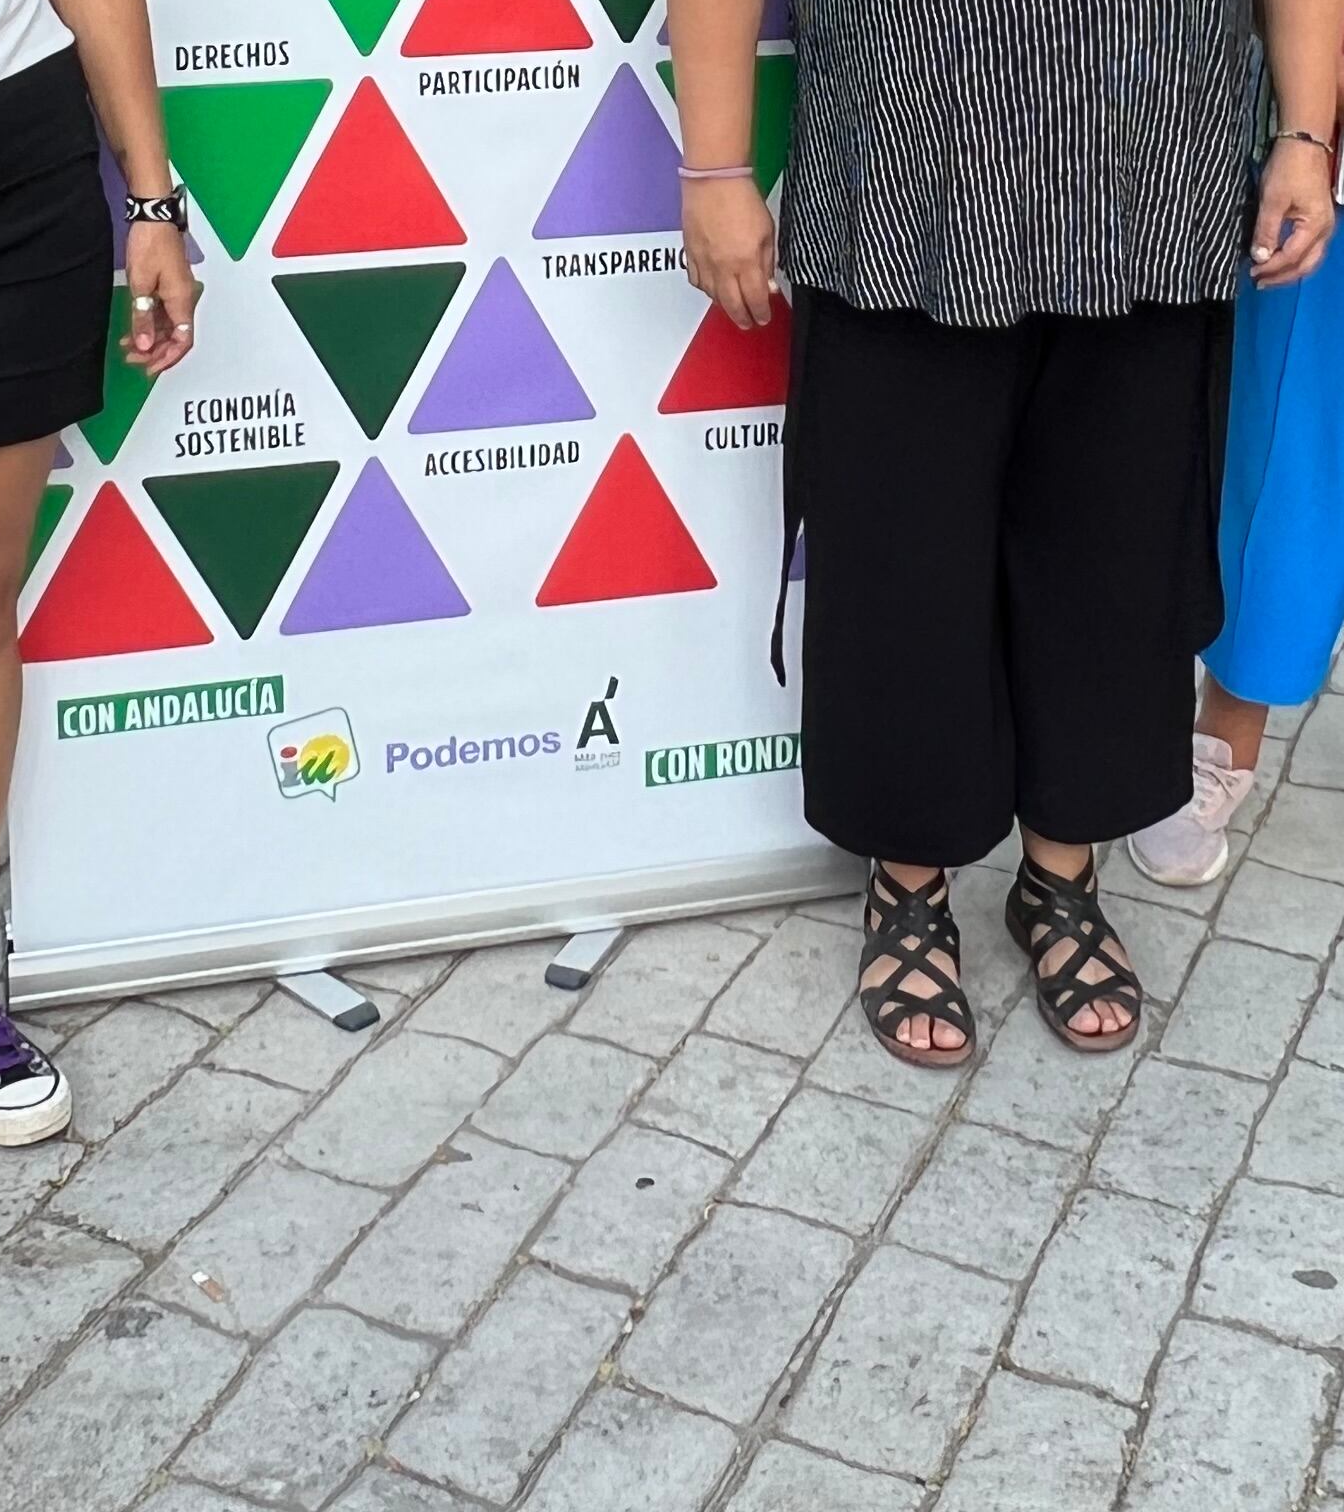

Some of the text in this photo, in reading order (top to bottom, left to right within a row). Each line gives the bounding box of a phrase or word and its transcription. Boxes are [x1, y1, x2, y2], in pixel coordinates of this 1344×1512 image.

[175, 41, 290, 71] DERECHOS
[419, 60, 581, 96] PARTICIPACIÓN
[183, 389, 296, 426] ECONOMÍA
[174, 423, 306, 458] SOSTENIBLE
[704, 422, 785, 451] CULTUR
[424, 441, 580, 477] ACCESIBILIDAD
[63, 678, 277, 737] CON ANDALUCÍA
[385, 730, 562, 774] Podemos
[651, 745, 707, 785] CON
